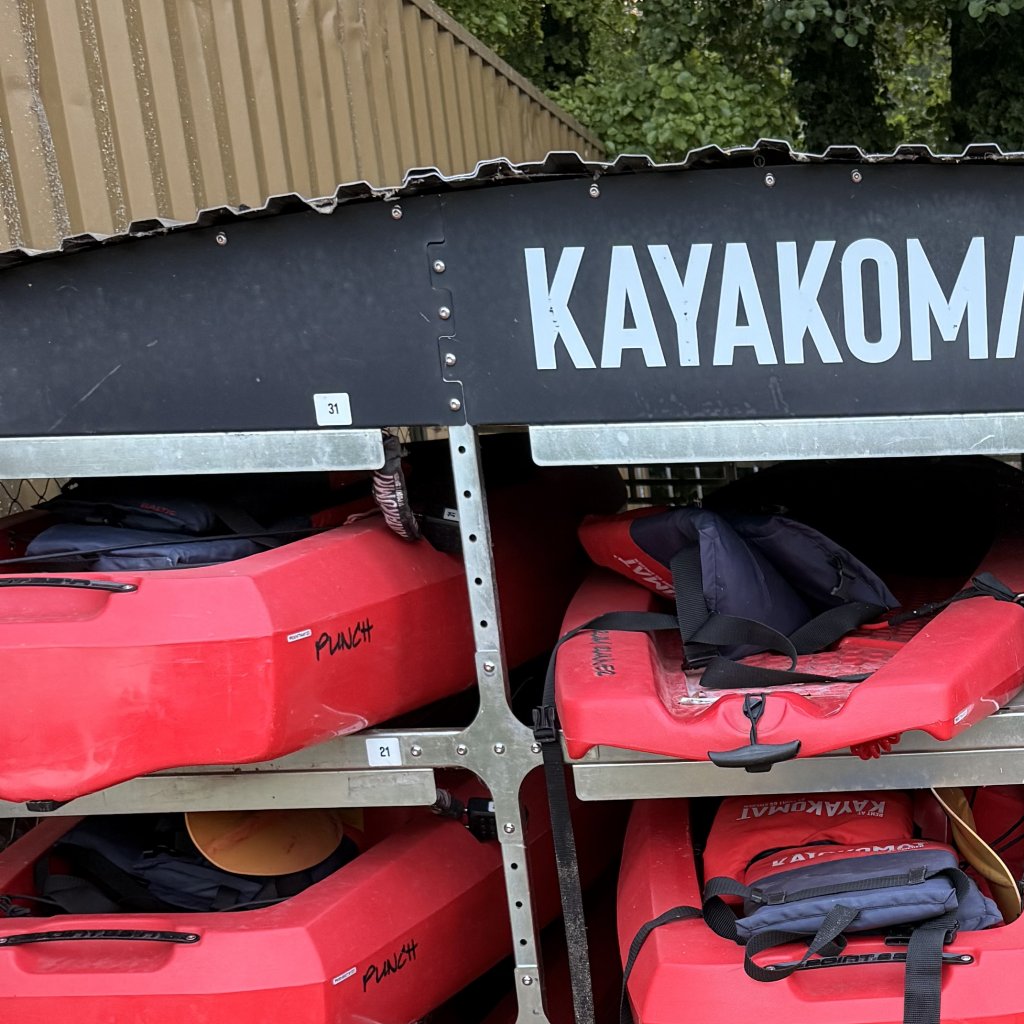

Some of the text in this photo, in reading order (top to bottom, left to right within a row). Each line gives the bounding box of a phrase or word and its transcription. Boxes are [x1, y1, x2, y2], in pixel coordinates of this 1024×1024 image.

[327, 403, 340, 415] 31
[315, 617, 374, 662] PUNCH
[379, 746, 391, 757] 21
[736, 799, 885, 821] KAYAKOMAT
[362, 938, 419, 992] PUNCH
